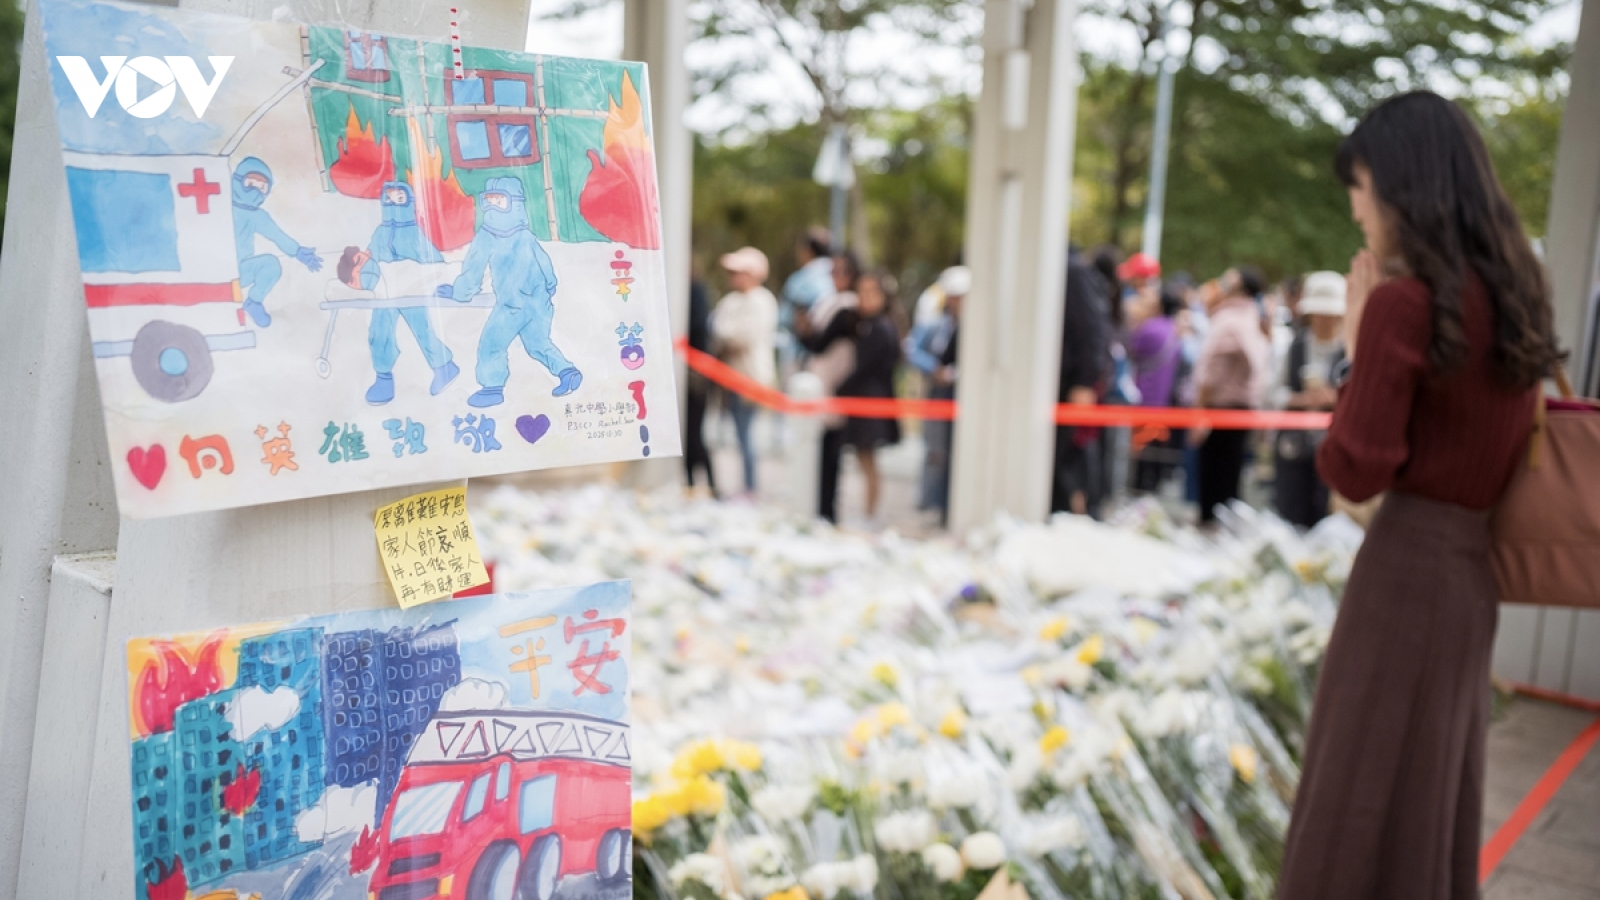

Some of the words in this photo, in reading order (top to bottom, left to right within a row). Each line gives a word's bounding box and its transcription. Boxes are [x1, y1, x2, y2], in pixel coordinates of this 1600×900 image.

[178, 413, 502, 479] 向英雄致敬
[499, 609, 626, 699] 平安
